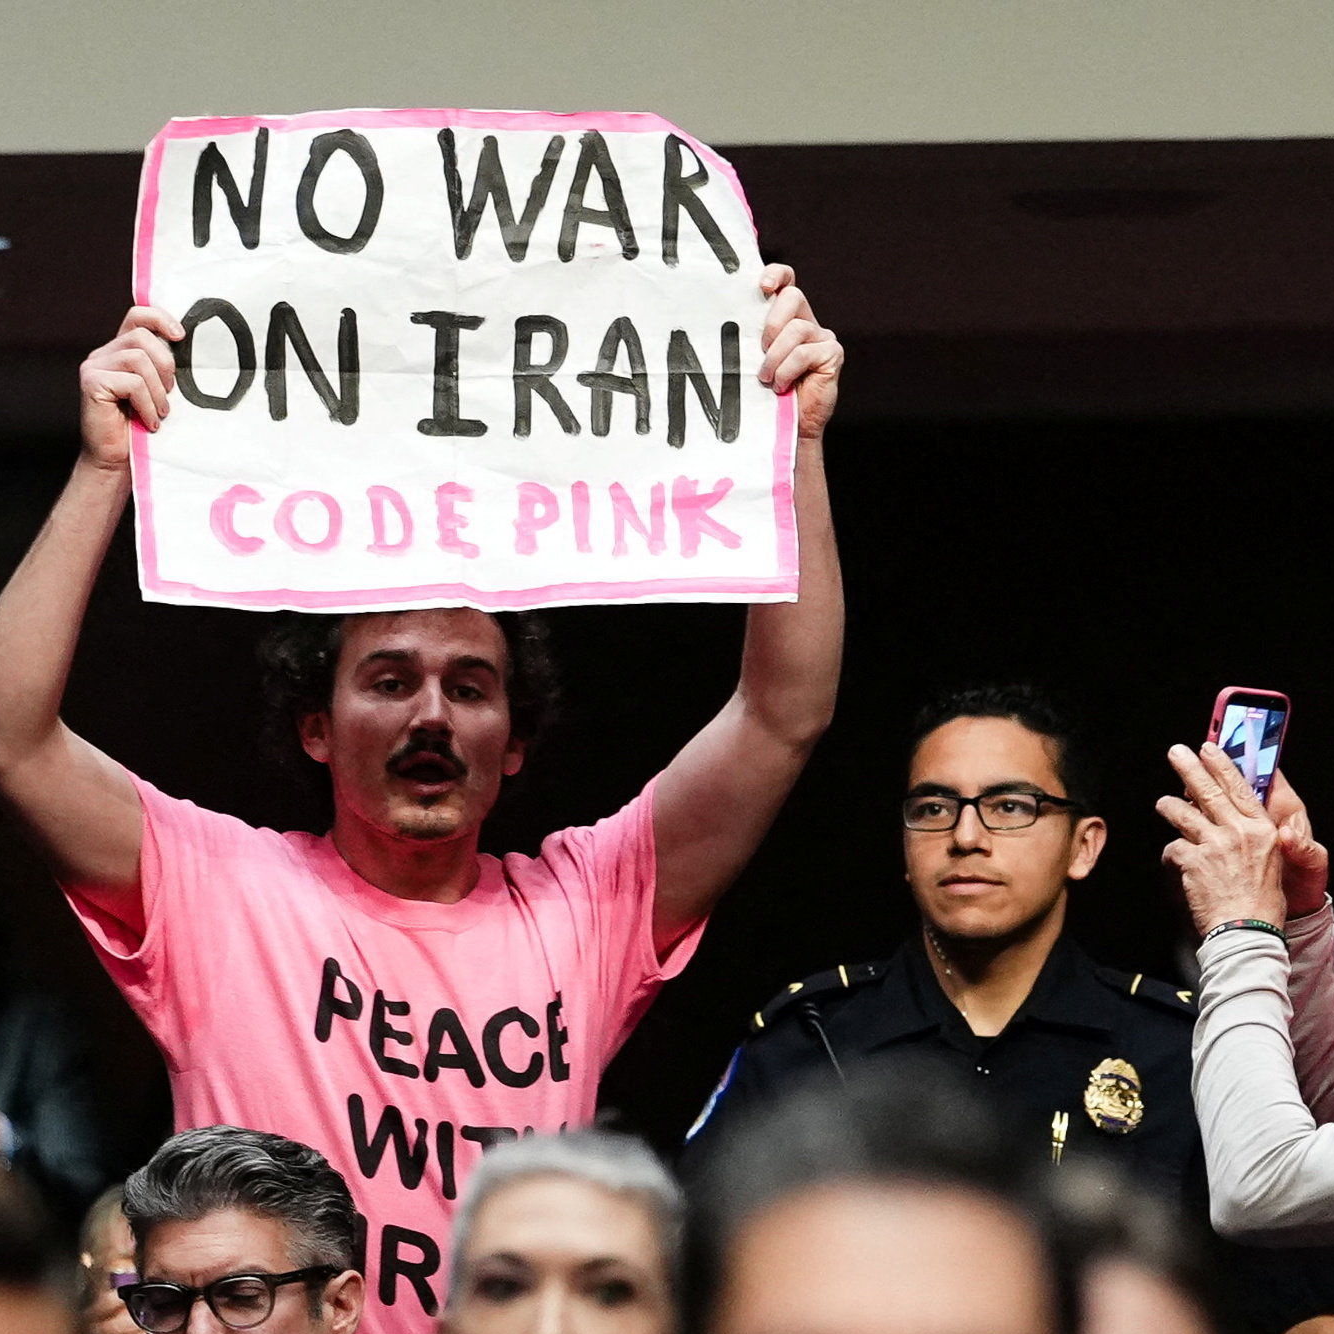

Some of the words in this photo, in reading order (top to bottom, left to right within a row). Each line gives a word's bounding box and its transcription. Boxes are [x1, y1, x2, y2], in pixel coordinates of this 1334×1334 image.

[192, 127, 384, 253] NO
[437, 128, 740, 273] WAR
[174, 298, 360, 425] ON
[410, 311, 740, 447] IRAN
[210, 482, 479, 558] CODE
[515, 477, 743, 556] PINK
[347, 1093, 567, 1200] WIT
